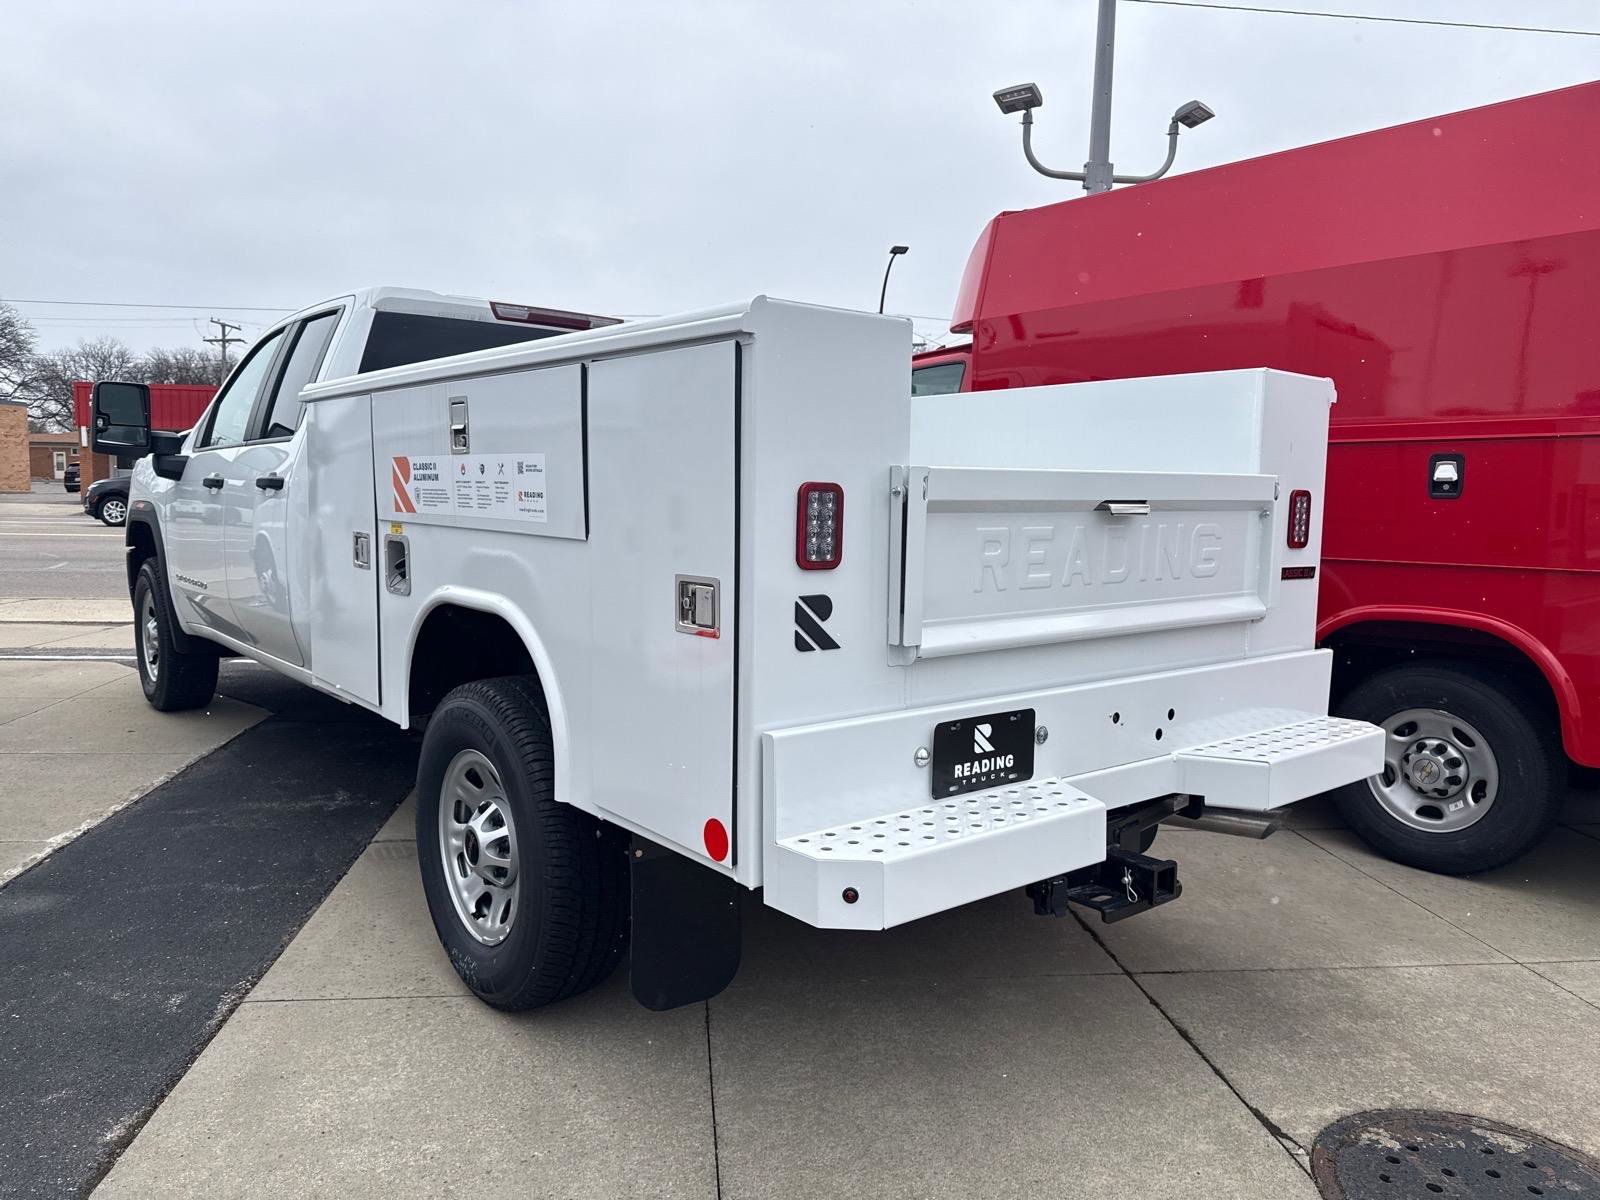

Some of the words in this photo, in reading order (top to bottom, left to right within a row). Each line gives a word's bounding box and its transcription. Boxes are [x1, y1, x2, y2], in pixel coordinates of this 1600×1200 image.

[413, 462, 432, 471] CLASSIC
[413, 473, 439, 482] ALUMINUM
[523, 490, 544, 499] READING
[973, 523, 1222, 593] READING
[954, 754, 1014, 779] READING
[962, 772, 1005, 785] TRUCK
